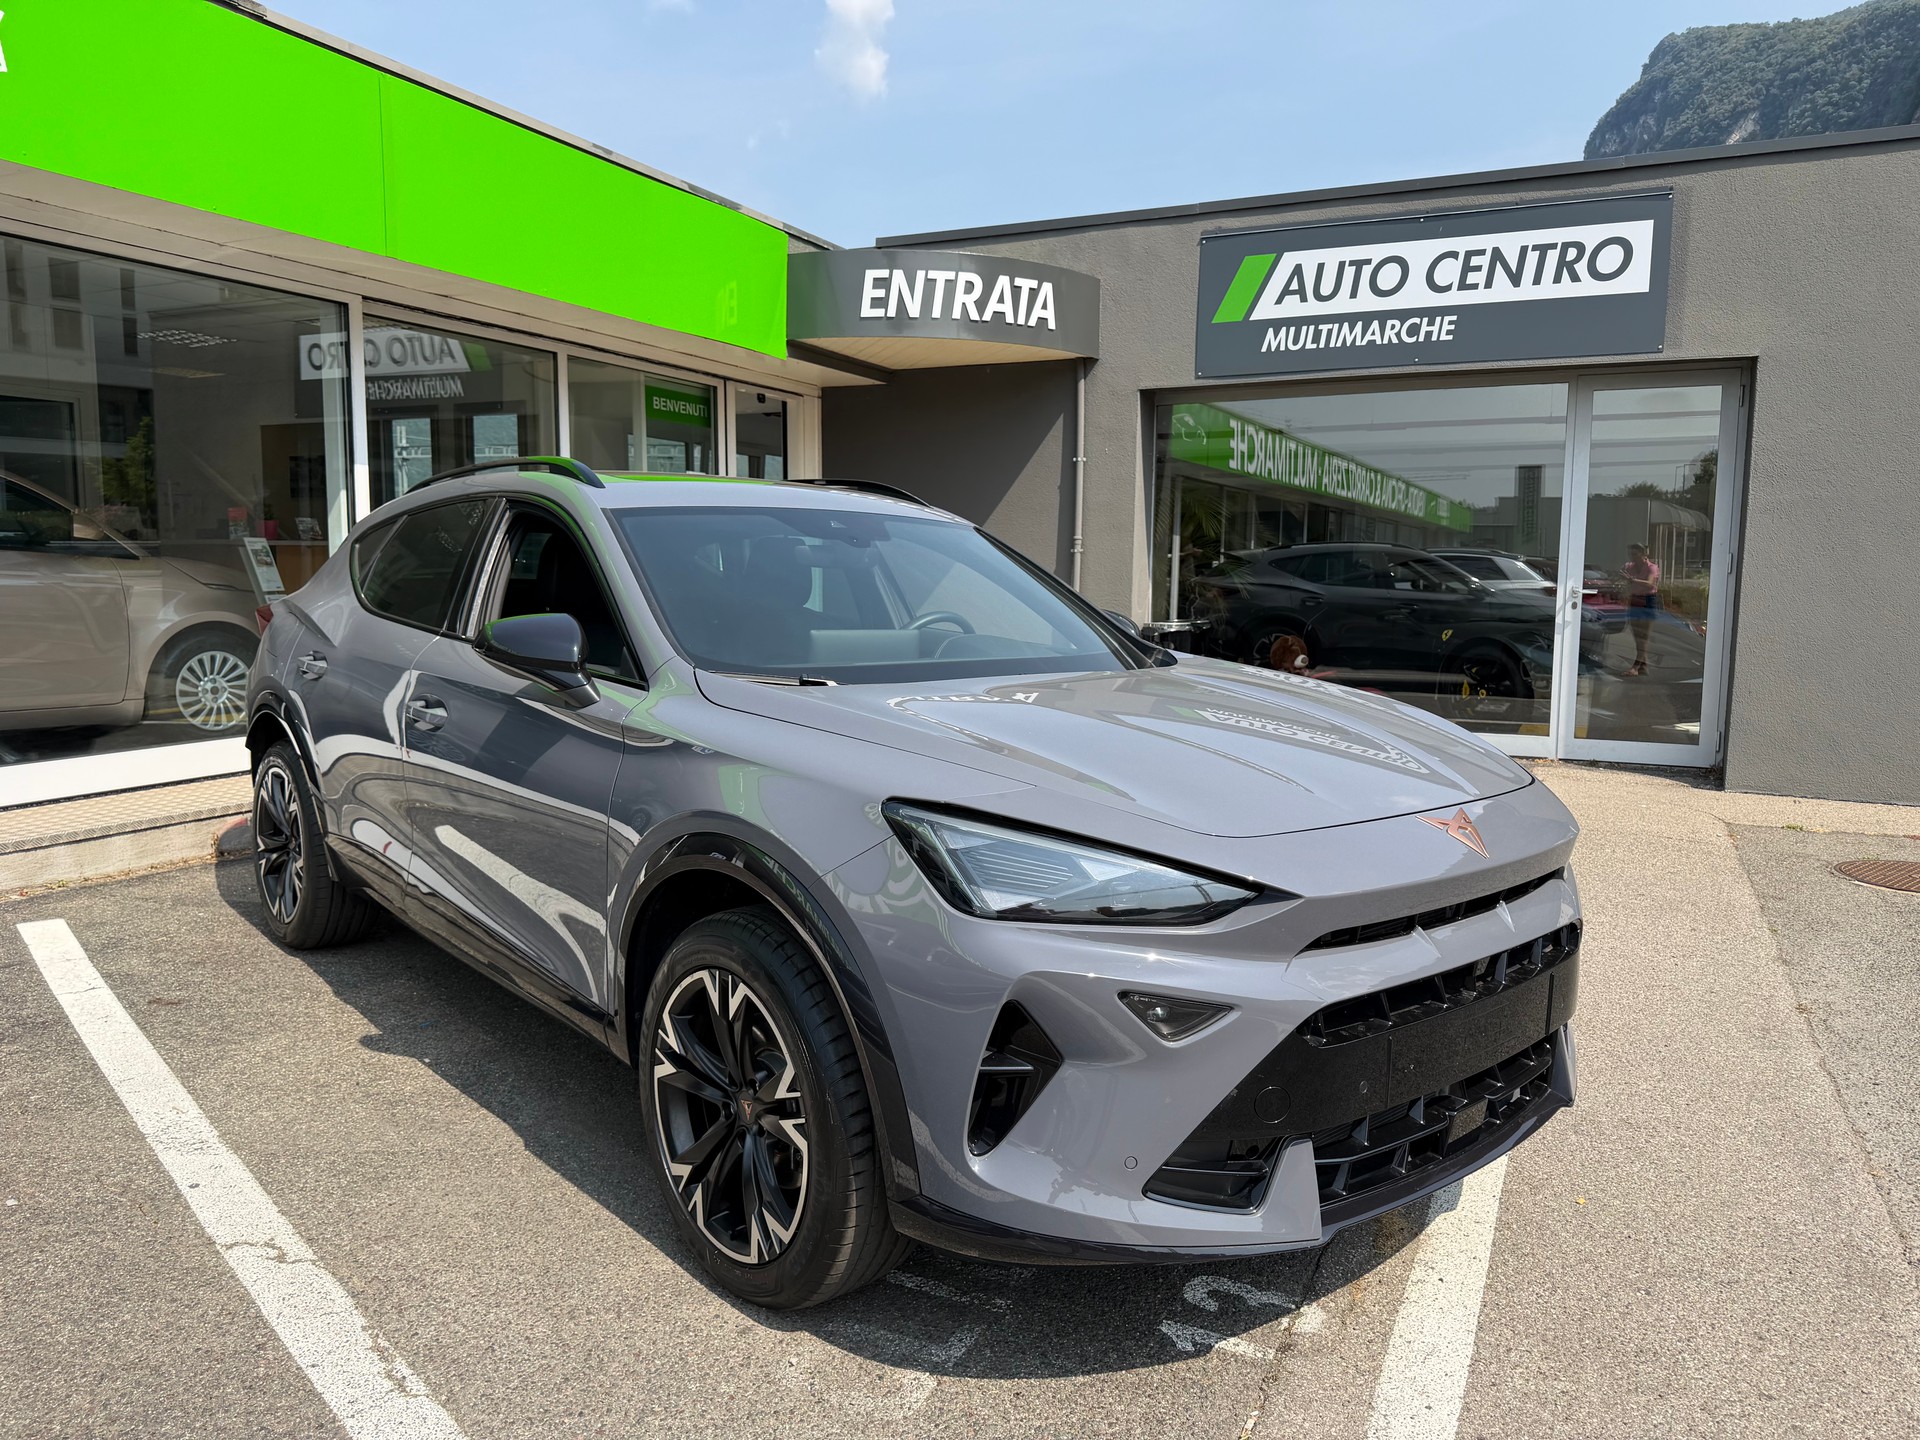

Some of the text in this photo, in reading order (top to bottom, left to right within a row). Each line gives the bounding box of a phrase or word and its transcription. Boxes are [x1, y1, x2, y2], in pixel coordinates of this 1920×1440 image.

[1274, 235, 1634, 306] AUTO CENTRO
[859, 267, 1057, 331] ENTRATA
[1260, 314, 1458, 353] MULTIMARCHE
[653, 396, 708, 418] BENVENUTI
